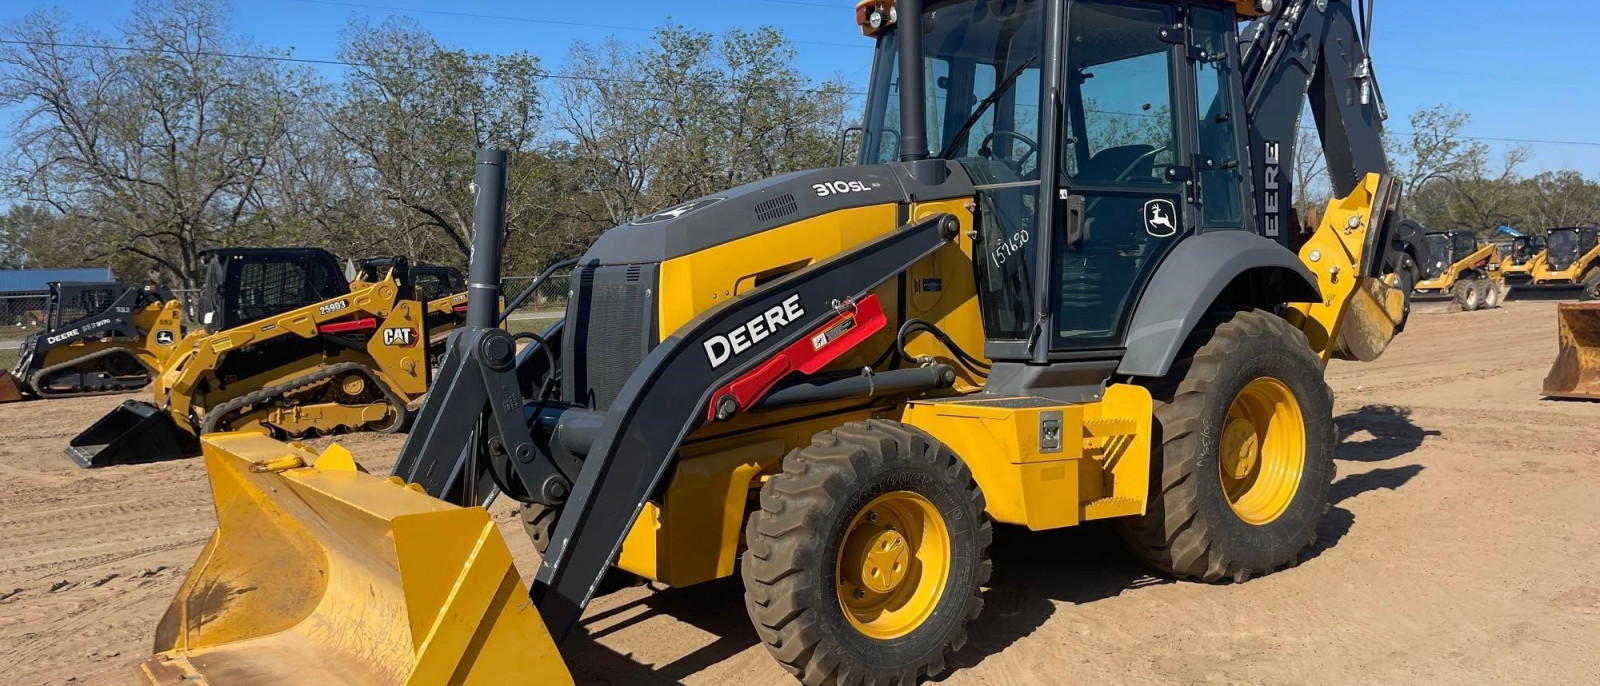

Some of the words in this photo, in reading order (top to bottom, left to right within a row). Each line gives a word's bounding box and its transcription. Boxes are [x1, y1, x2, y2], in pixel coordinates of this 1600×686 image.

[812, 180, 872, 197] 310SL
[1264, 142, 1280, 237] EERE
[319, 301, 346, 315] 259D3
[47, 328, 80, 345] DEERE
[383, 327, 411, 346] CAT
[703, 293, 806, 369] DEERE
